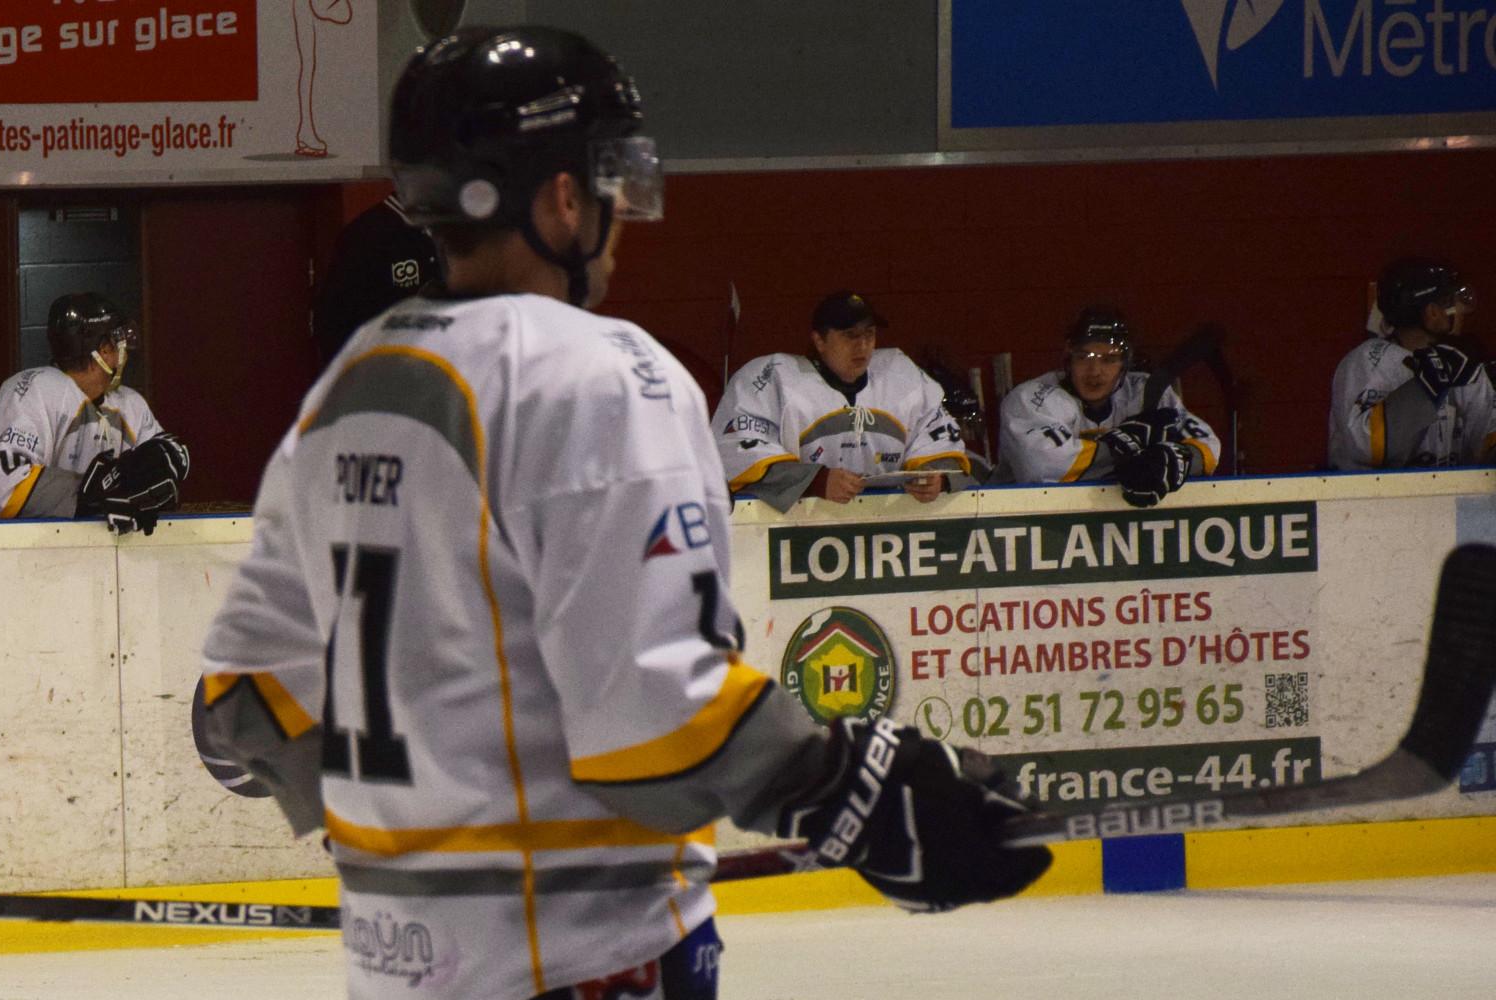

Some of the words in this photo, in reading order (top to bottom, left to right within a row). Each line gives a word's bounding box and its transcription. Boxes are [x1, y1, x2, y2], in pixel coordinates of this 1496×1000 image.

[60, 20, 120, 49] sur
[135, 11, 239, 51] glace
[779, 512, 1311, 585] LOIRE-ATLANTIQUE
[911, 597, 1106, 637] LOCATIONS
[1114, 589, 1213, 627] GÎTES
[912, 651, 947, 680] ET
[961, 638, 1153, 677] CHAMBRES
[962, 700, 1009, 738] 02
[1024, 696, 1062, 735] 51
[1080, 692, 1125, 731] 72
[1138, 688, 1185, 728] 95
[1196, 685, 1245, 725] 65
[1017, 752, 1311, 802] france-44.fr
[133, 902, 273, 926] NEXUS
